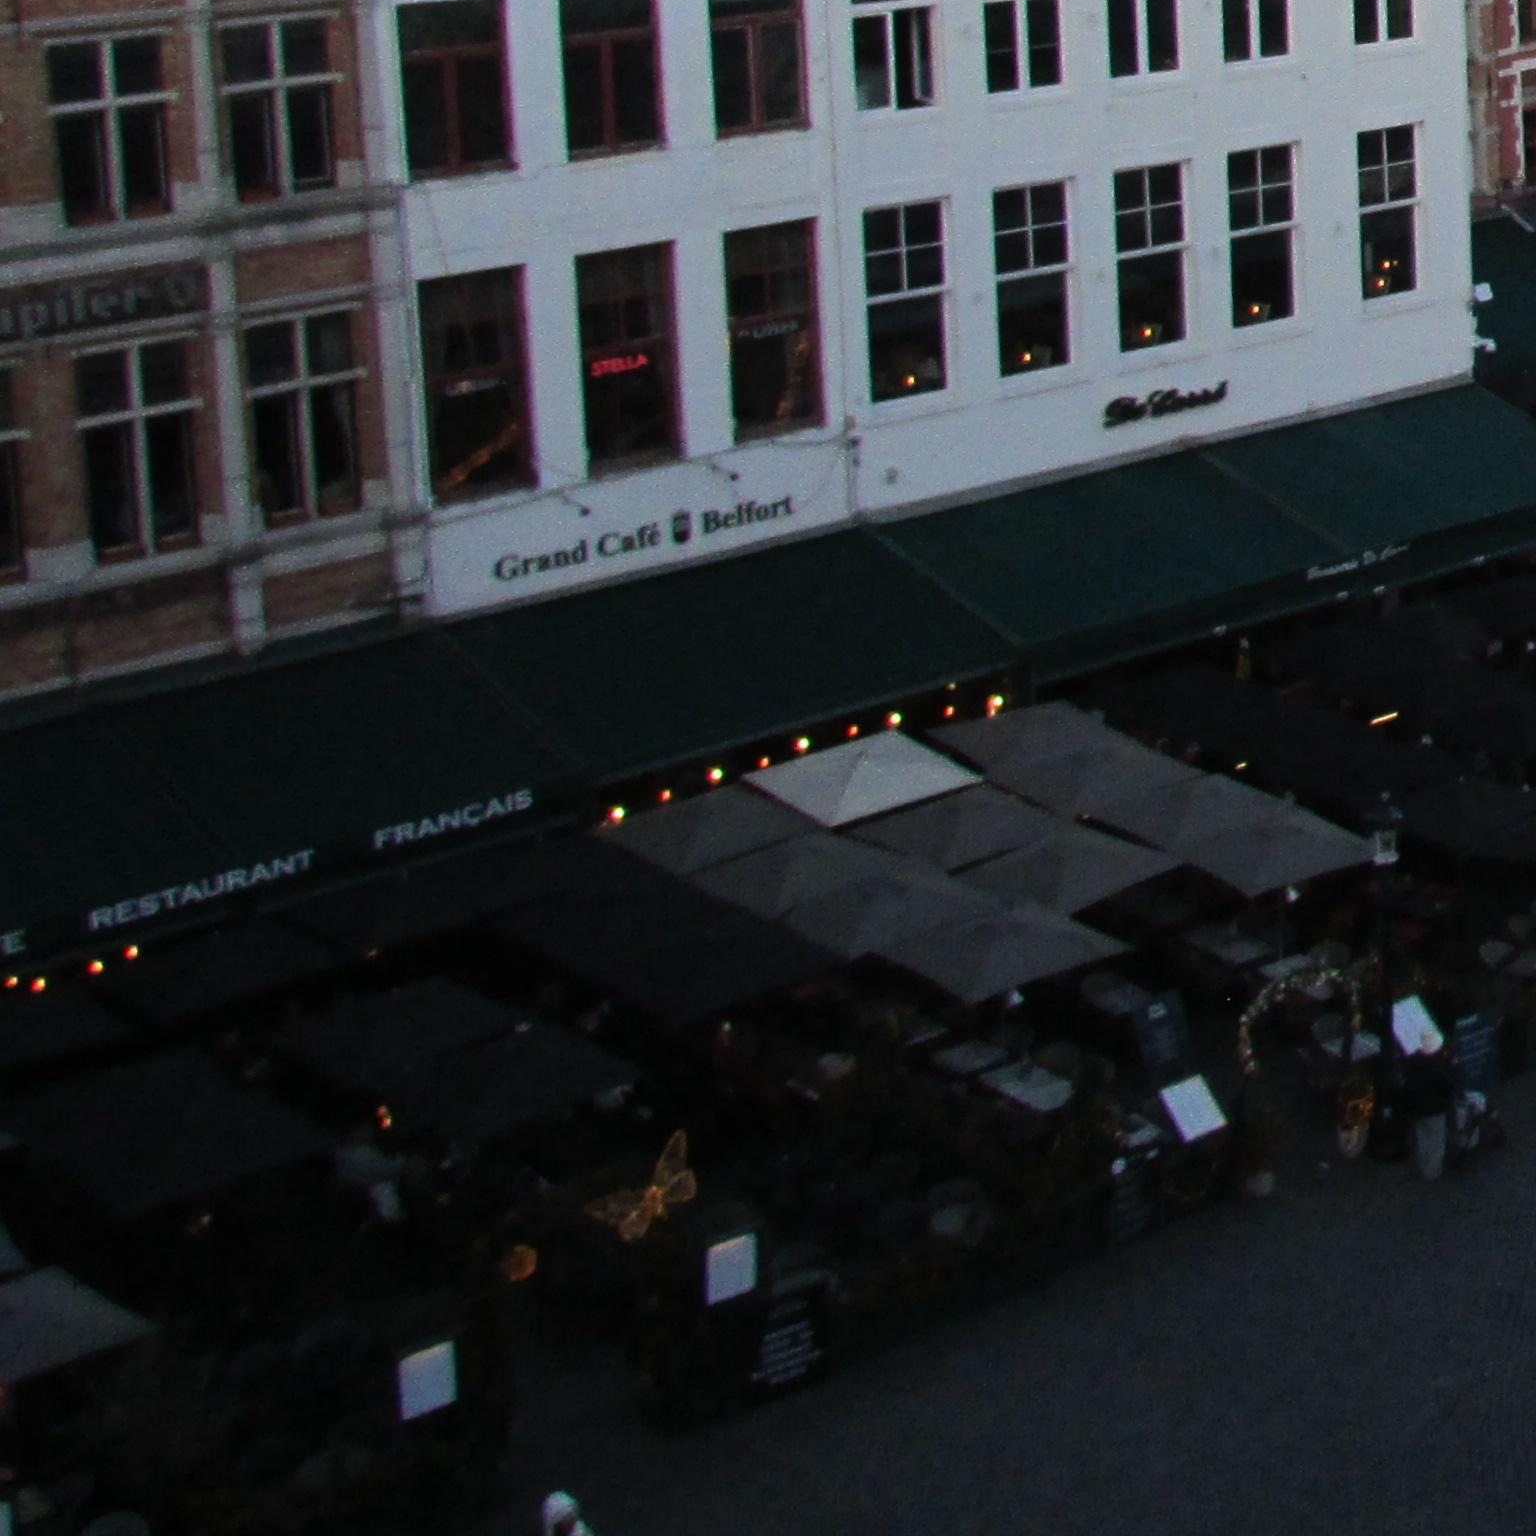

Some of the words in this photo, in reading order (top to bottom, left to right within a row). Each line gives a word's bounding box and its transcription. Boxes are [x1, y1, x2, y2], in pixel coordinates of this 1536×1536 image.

[590, 352, 650, 378] STELLA
[494, 540, 590, 583] Grand
[597, 521, 664, 558] Café
[701, 494, 795, 536] Belfort
[87, 847, 316, 932] RESTAURANT
[372, 787, 536, 852] FRANÇAIS
